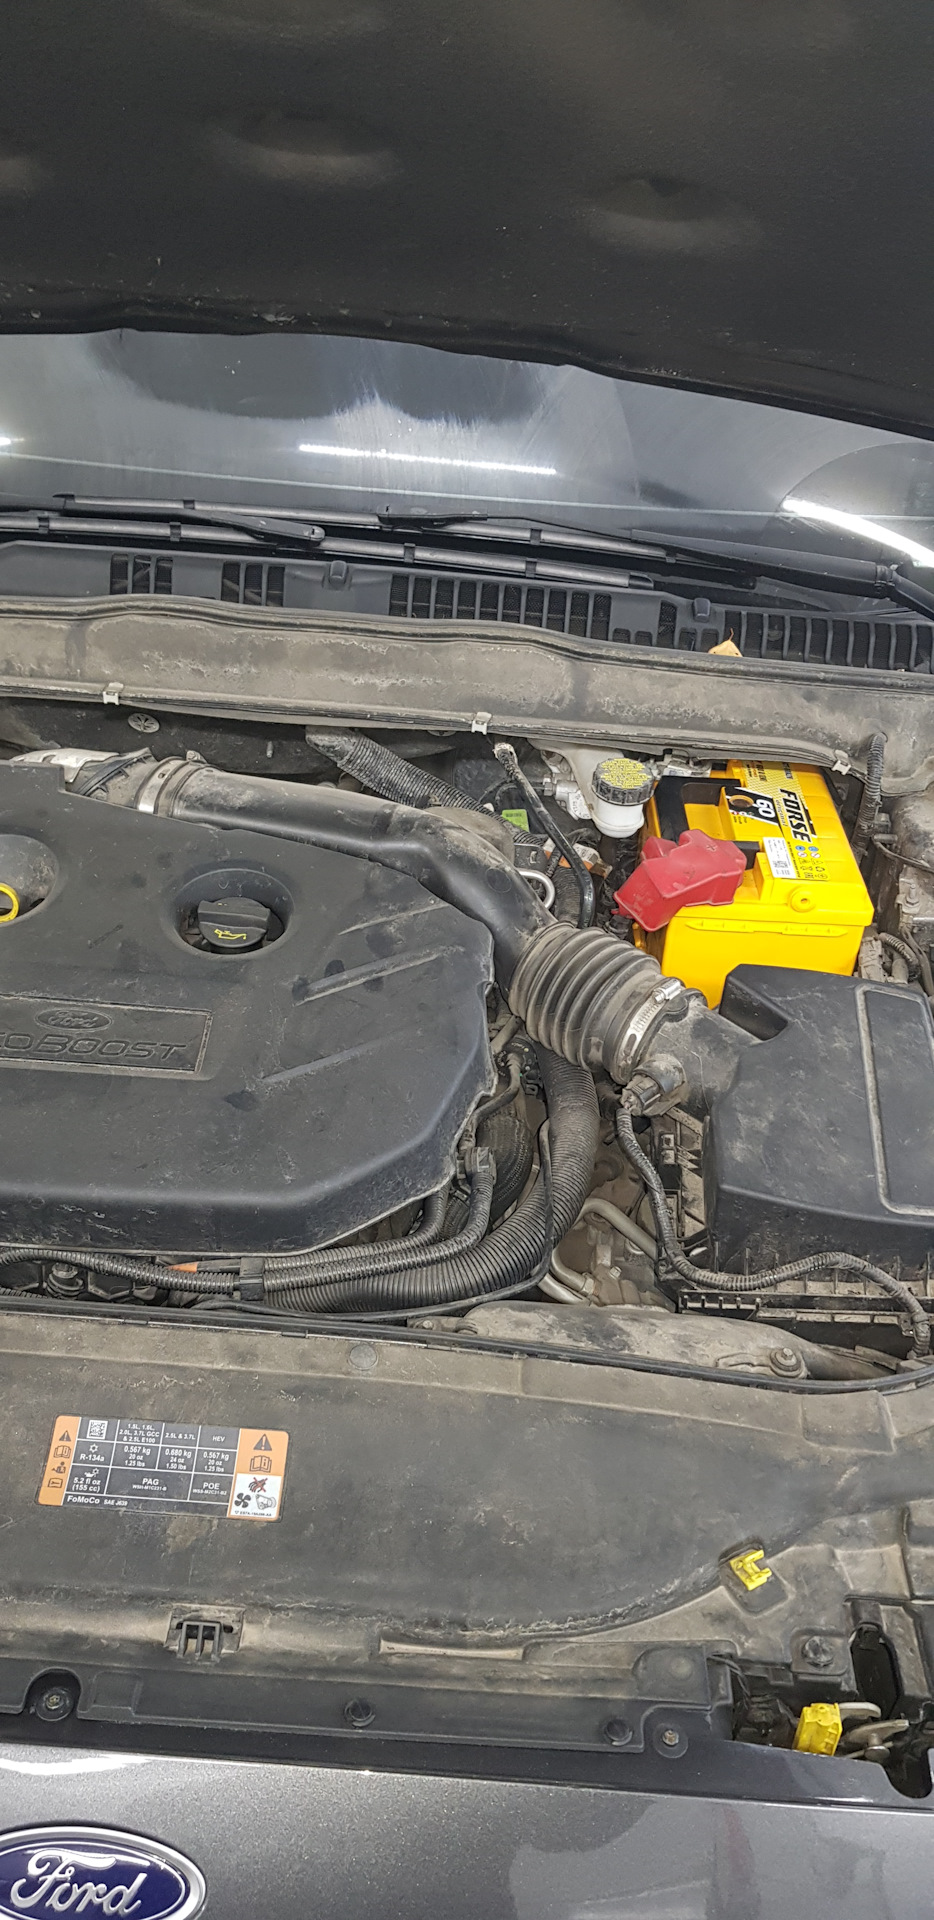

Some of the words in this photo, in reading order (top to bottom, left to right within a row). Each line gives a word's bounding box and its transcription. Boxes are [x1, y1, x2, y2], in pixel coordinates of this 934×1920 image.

[756, 799, 776, 818] 60
[780, 788, 812, 842] FORSE
[48, 1010, 98, 1028] Ford
[0, 1032, 186, 1060] OBOOST
[142, 1446, 151, 1455] kg
[183, 1449, 192, 1458] kg
[221, 1453, 229, 1461] kg
[67, 1495, 100, 1504] FoMoCo
[10, 1848, 148, 1916] Ford
